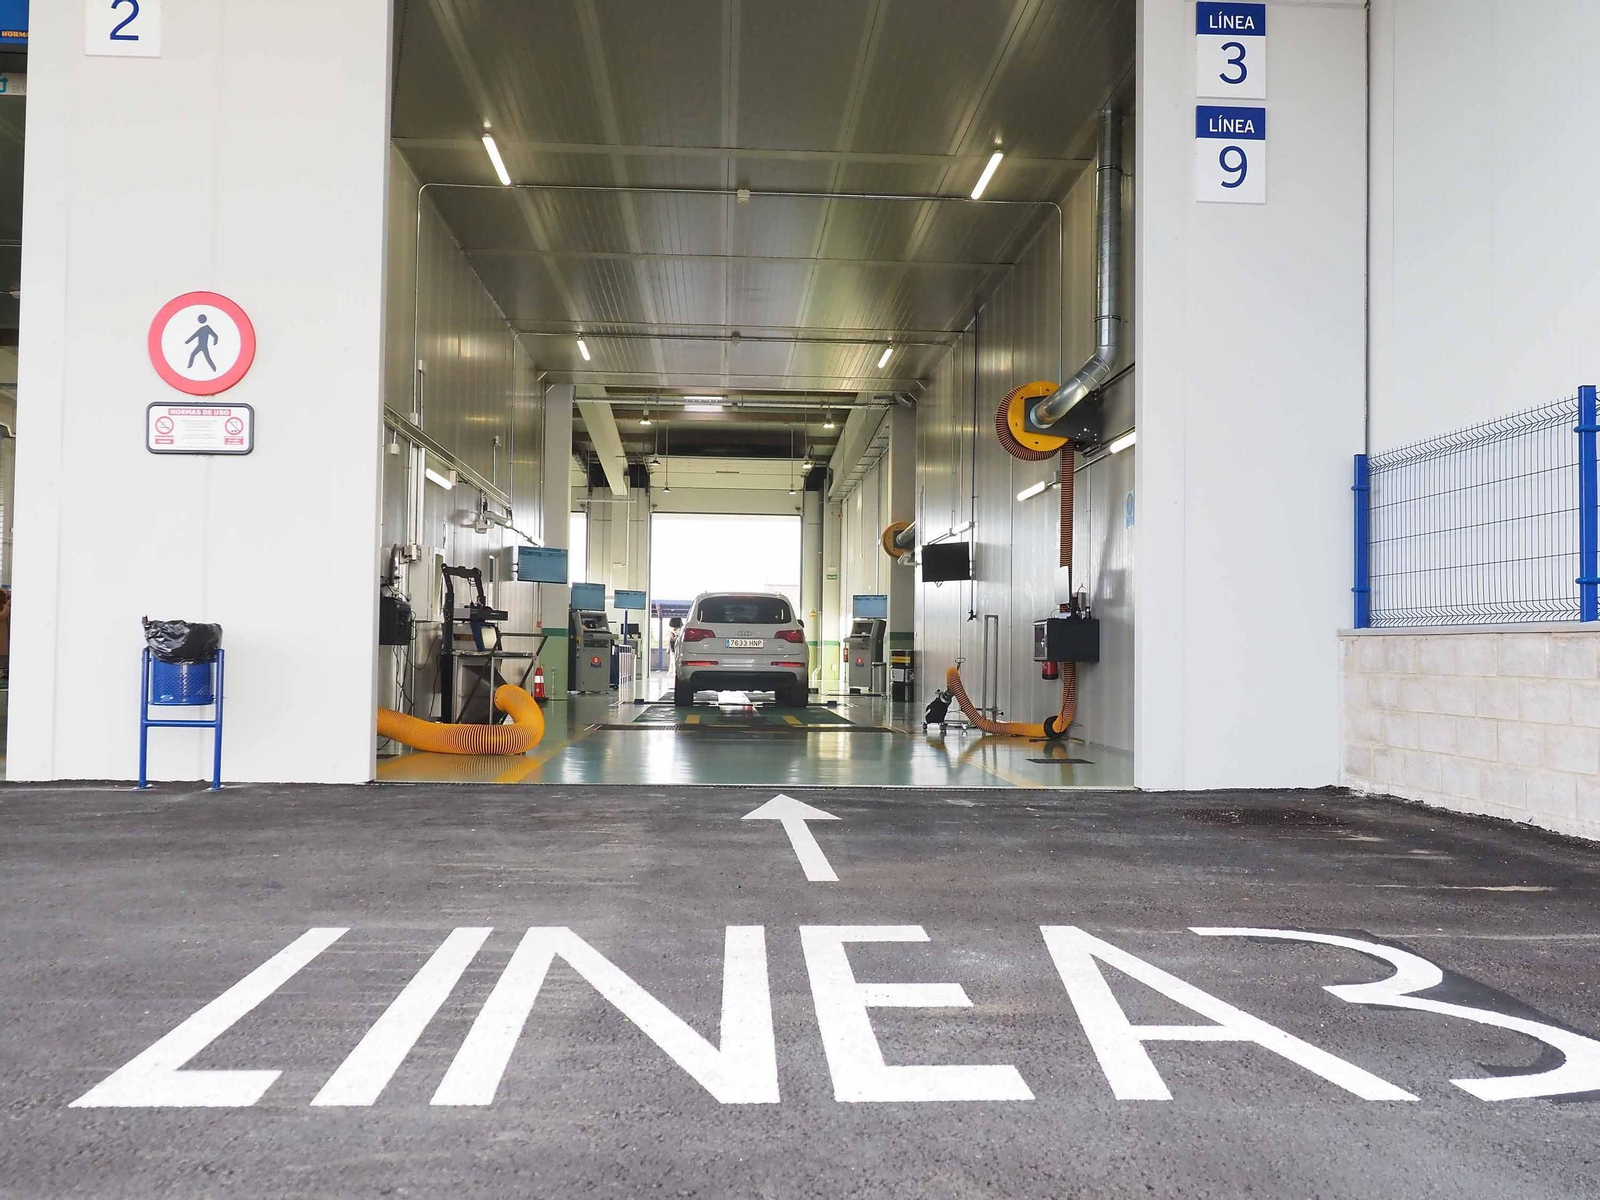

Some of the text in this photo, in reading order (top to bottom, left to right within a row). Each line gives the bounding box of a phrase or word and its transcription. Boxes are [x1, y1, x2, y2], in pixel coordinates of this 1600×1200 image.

[110, 0, 139, 40] 2
[1209, 11, 1255, 30] LÍNEA
[1220, 42, 1248, 84] 3
[1209, 114, 1255, 133] LÍNEA
[1219, 146, 1248, 189] 9
[731, 639, 747, 647] 7633
[69, 925, 1600, 1108] LINEA 3
